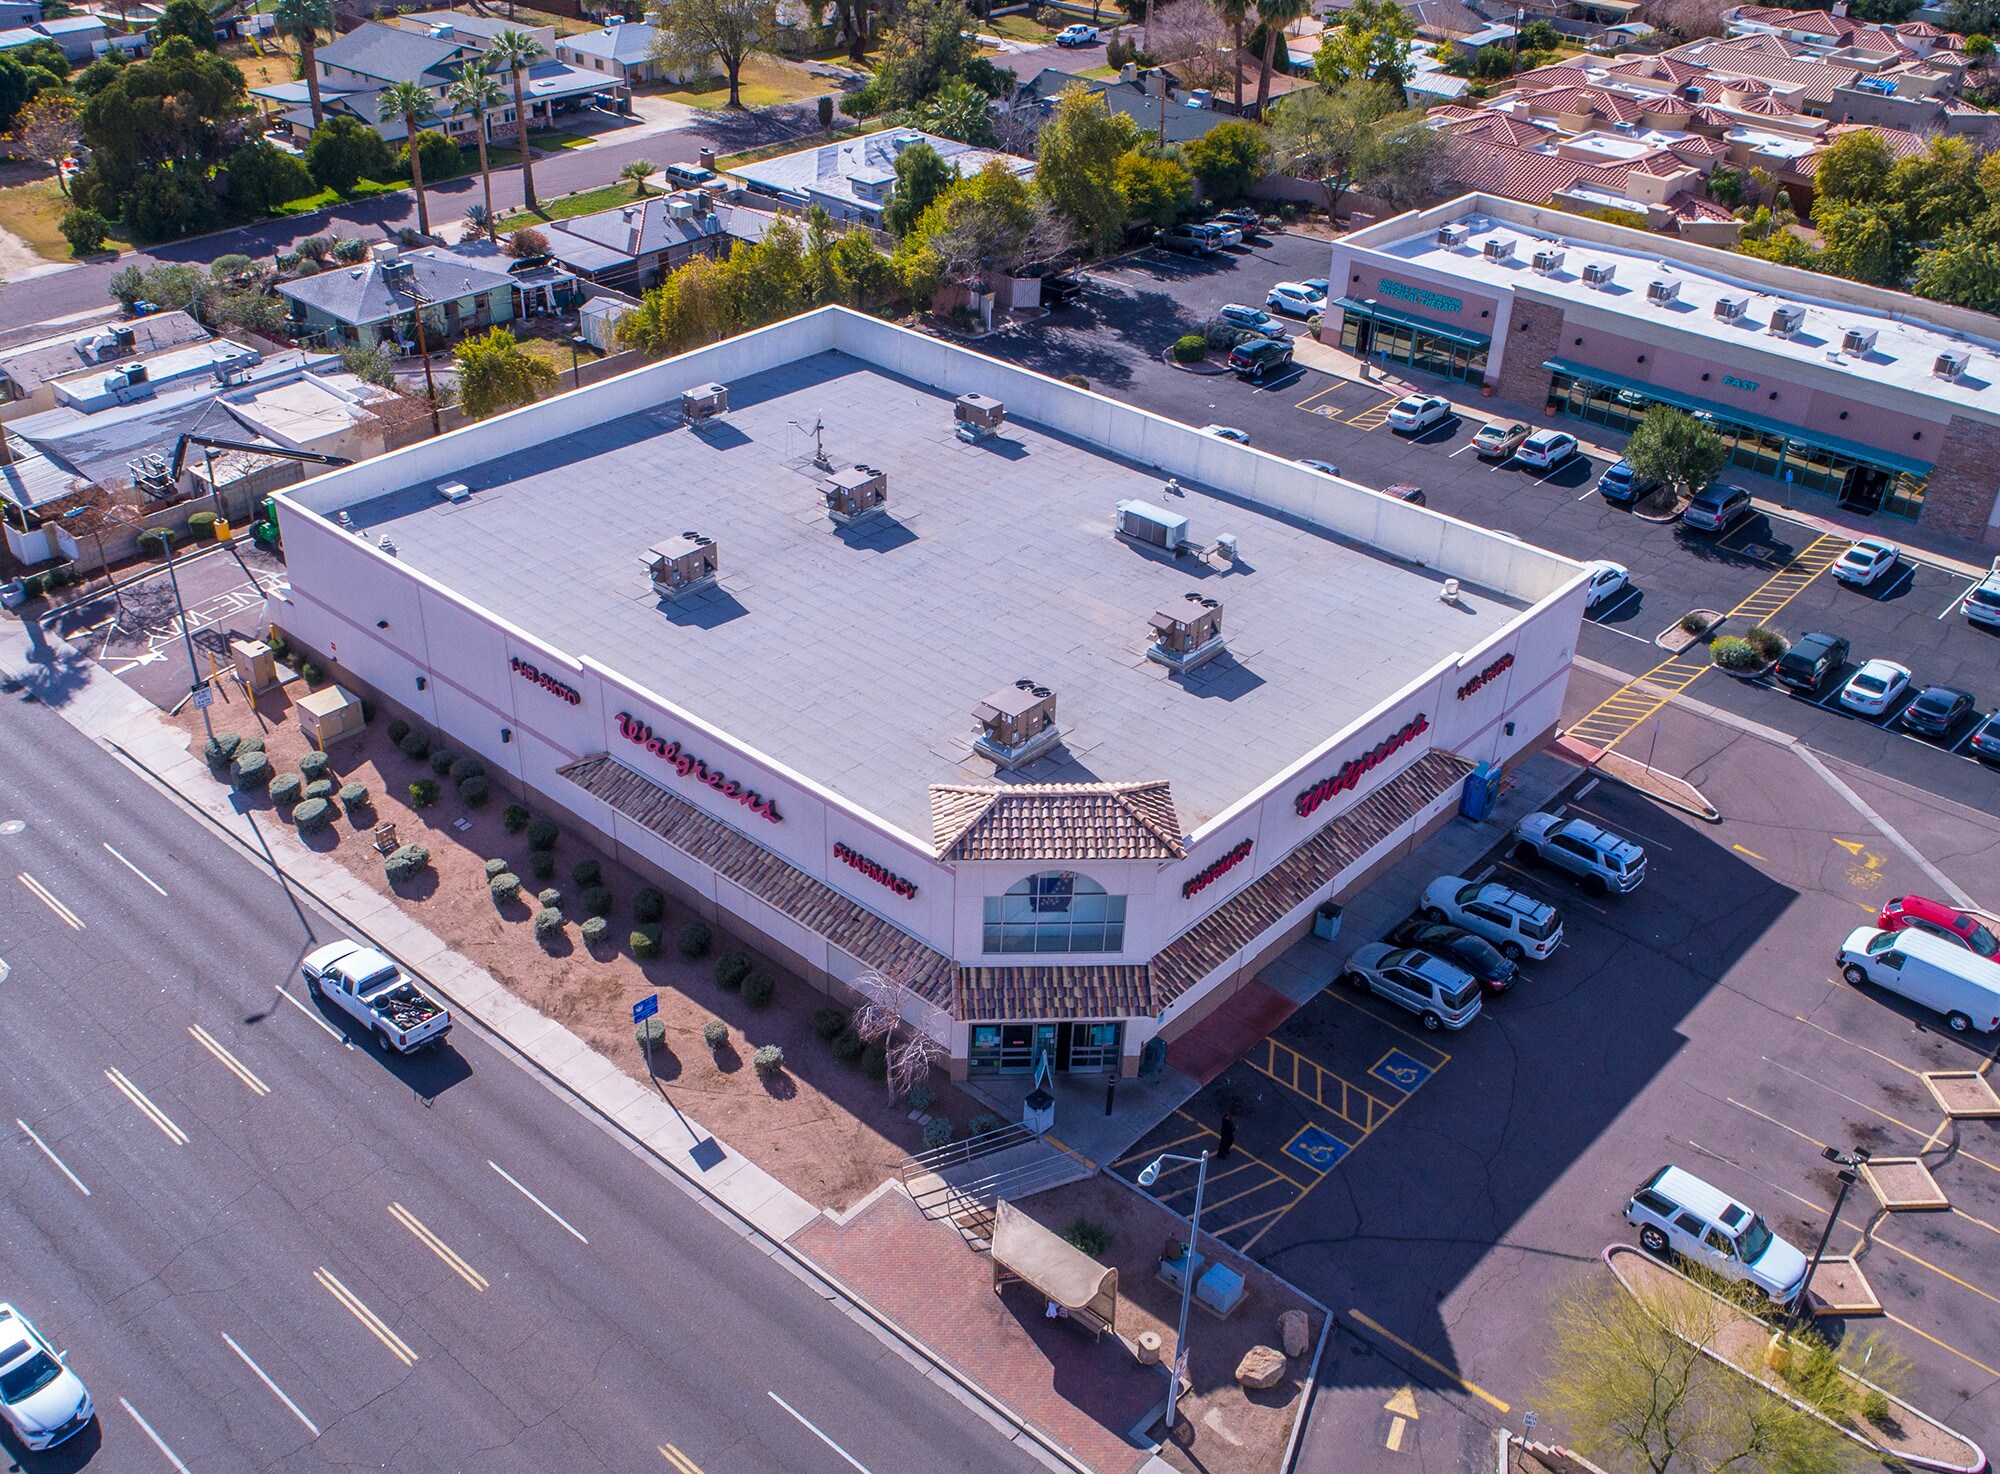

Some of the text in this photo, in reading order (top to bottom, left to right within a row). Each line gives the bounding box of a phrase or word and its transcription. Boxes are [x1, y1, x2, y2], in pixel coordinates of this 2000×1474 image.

[1378, 286, 1462, 314] PHYSICAL THERAPY
[1722, 375, 1760, 392] FAST
[539, 672, 581, 706] PHOTO
[1481, 652, 1515, 685] PHOTO
[615, 711, 783, 824] Walgreens
[1294, 712, 1430, 818] Walgreens
[833, 842, 918, 901] PHARMACY
[1182, 837, 1254, 900] PHARMACY
